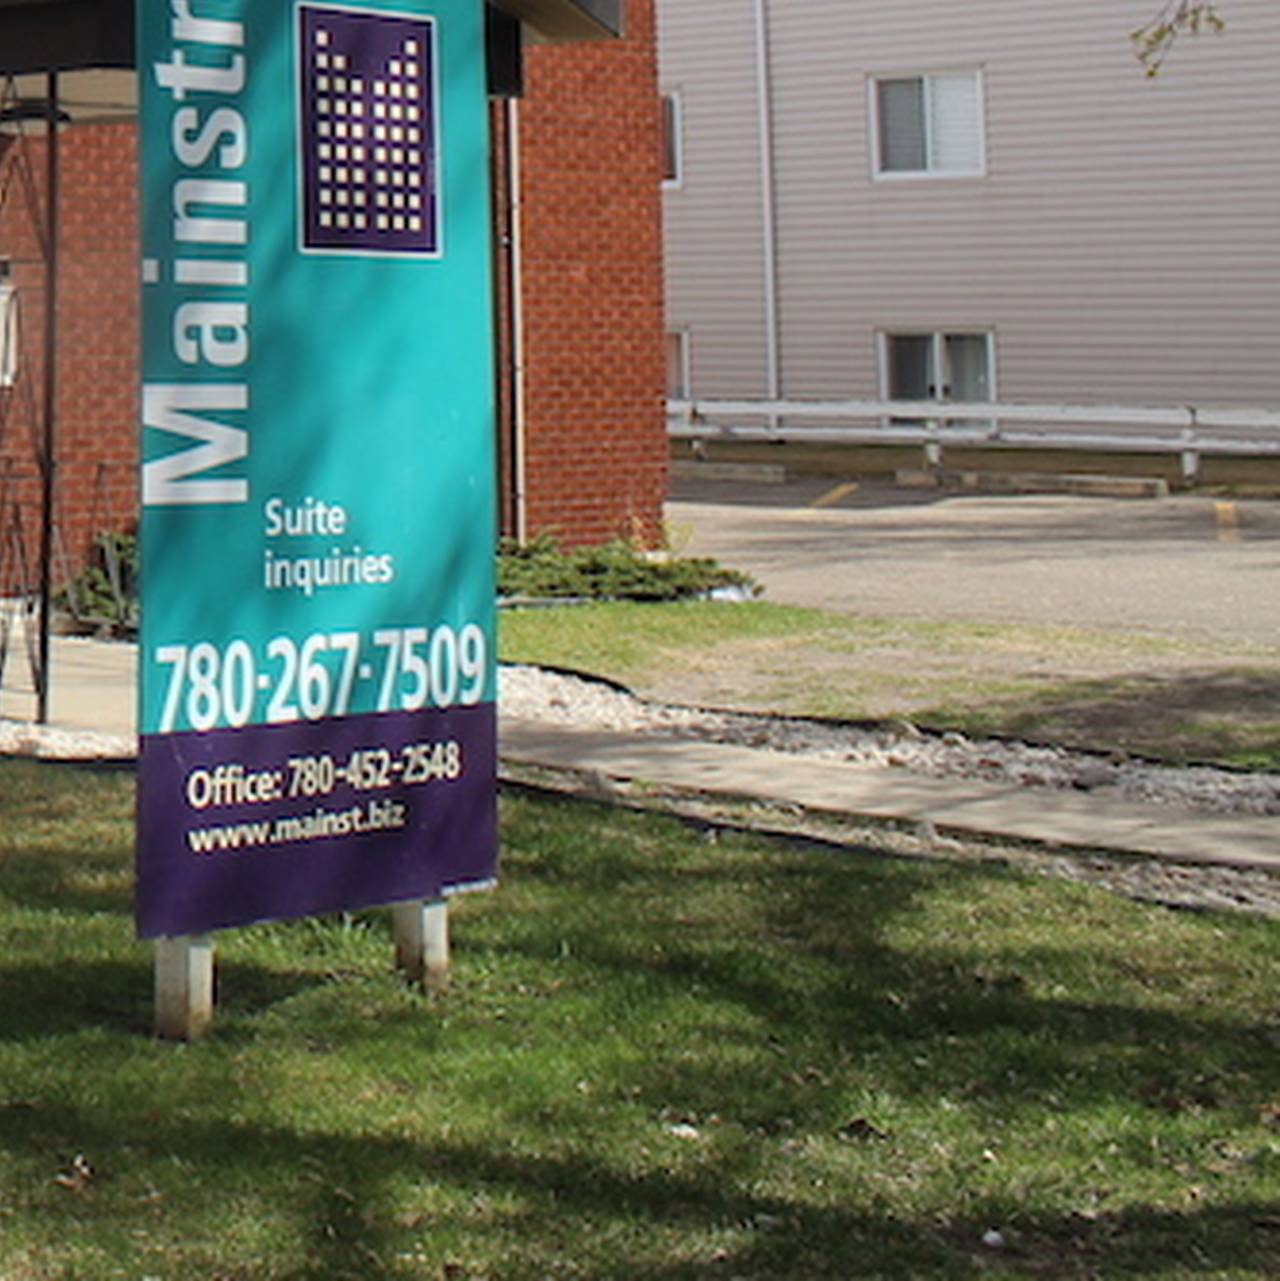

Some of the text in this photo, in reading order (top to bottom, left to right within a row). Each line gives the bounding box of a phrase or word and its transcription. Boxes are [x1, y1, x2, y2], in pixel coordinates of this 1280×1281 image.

[264, 497, 346, 536] Suite
[264, 546, 394, 595] inquiries
[187, 741, 460, 809] Office: 780-452-2548
[188, 799, 405, 852] www.mainst.biz
